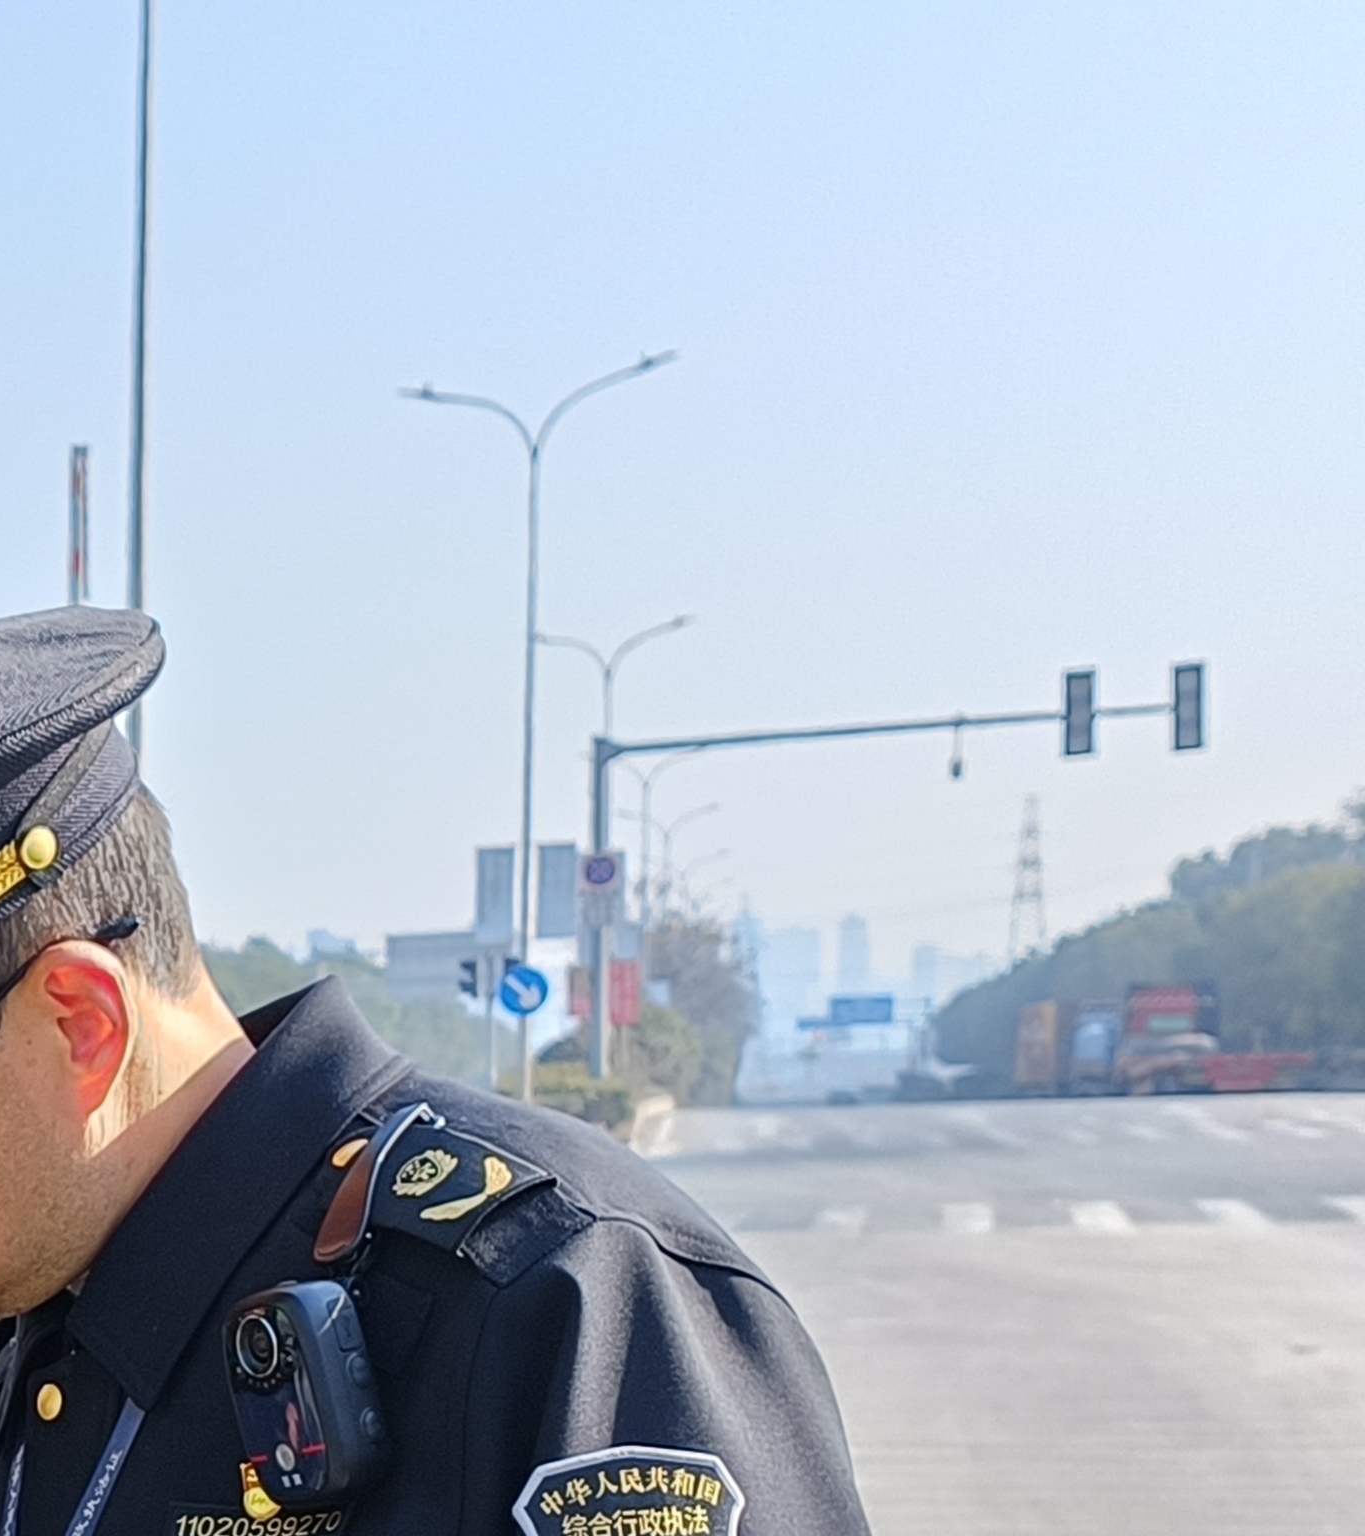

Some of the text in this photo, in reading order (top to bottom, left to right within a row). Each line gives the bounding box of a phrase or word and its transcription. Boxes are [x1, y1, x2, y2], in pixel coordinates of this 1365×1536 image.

[539, 1466, 722, 1517] 中华人民共和国
